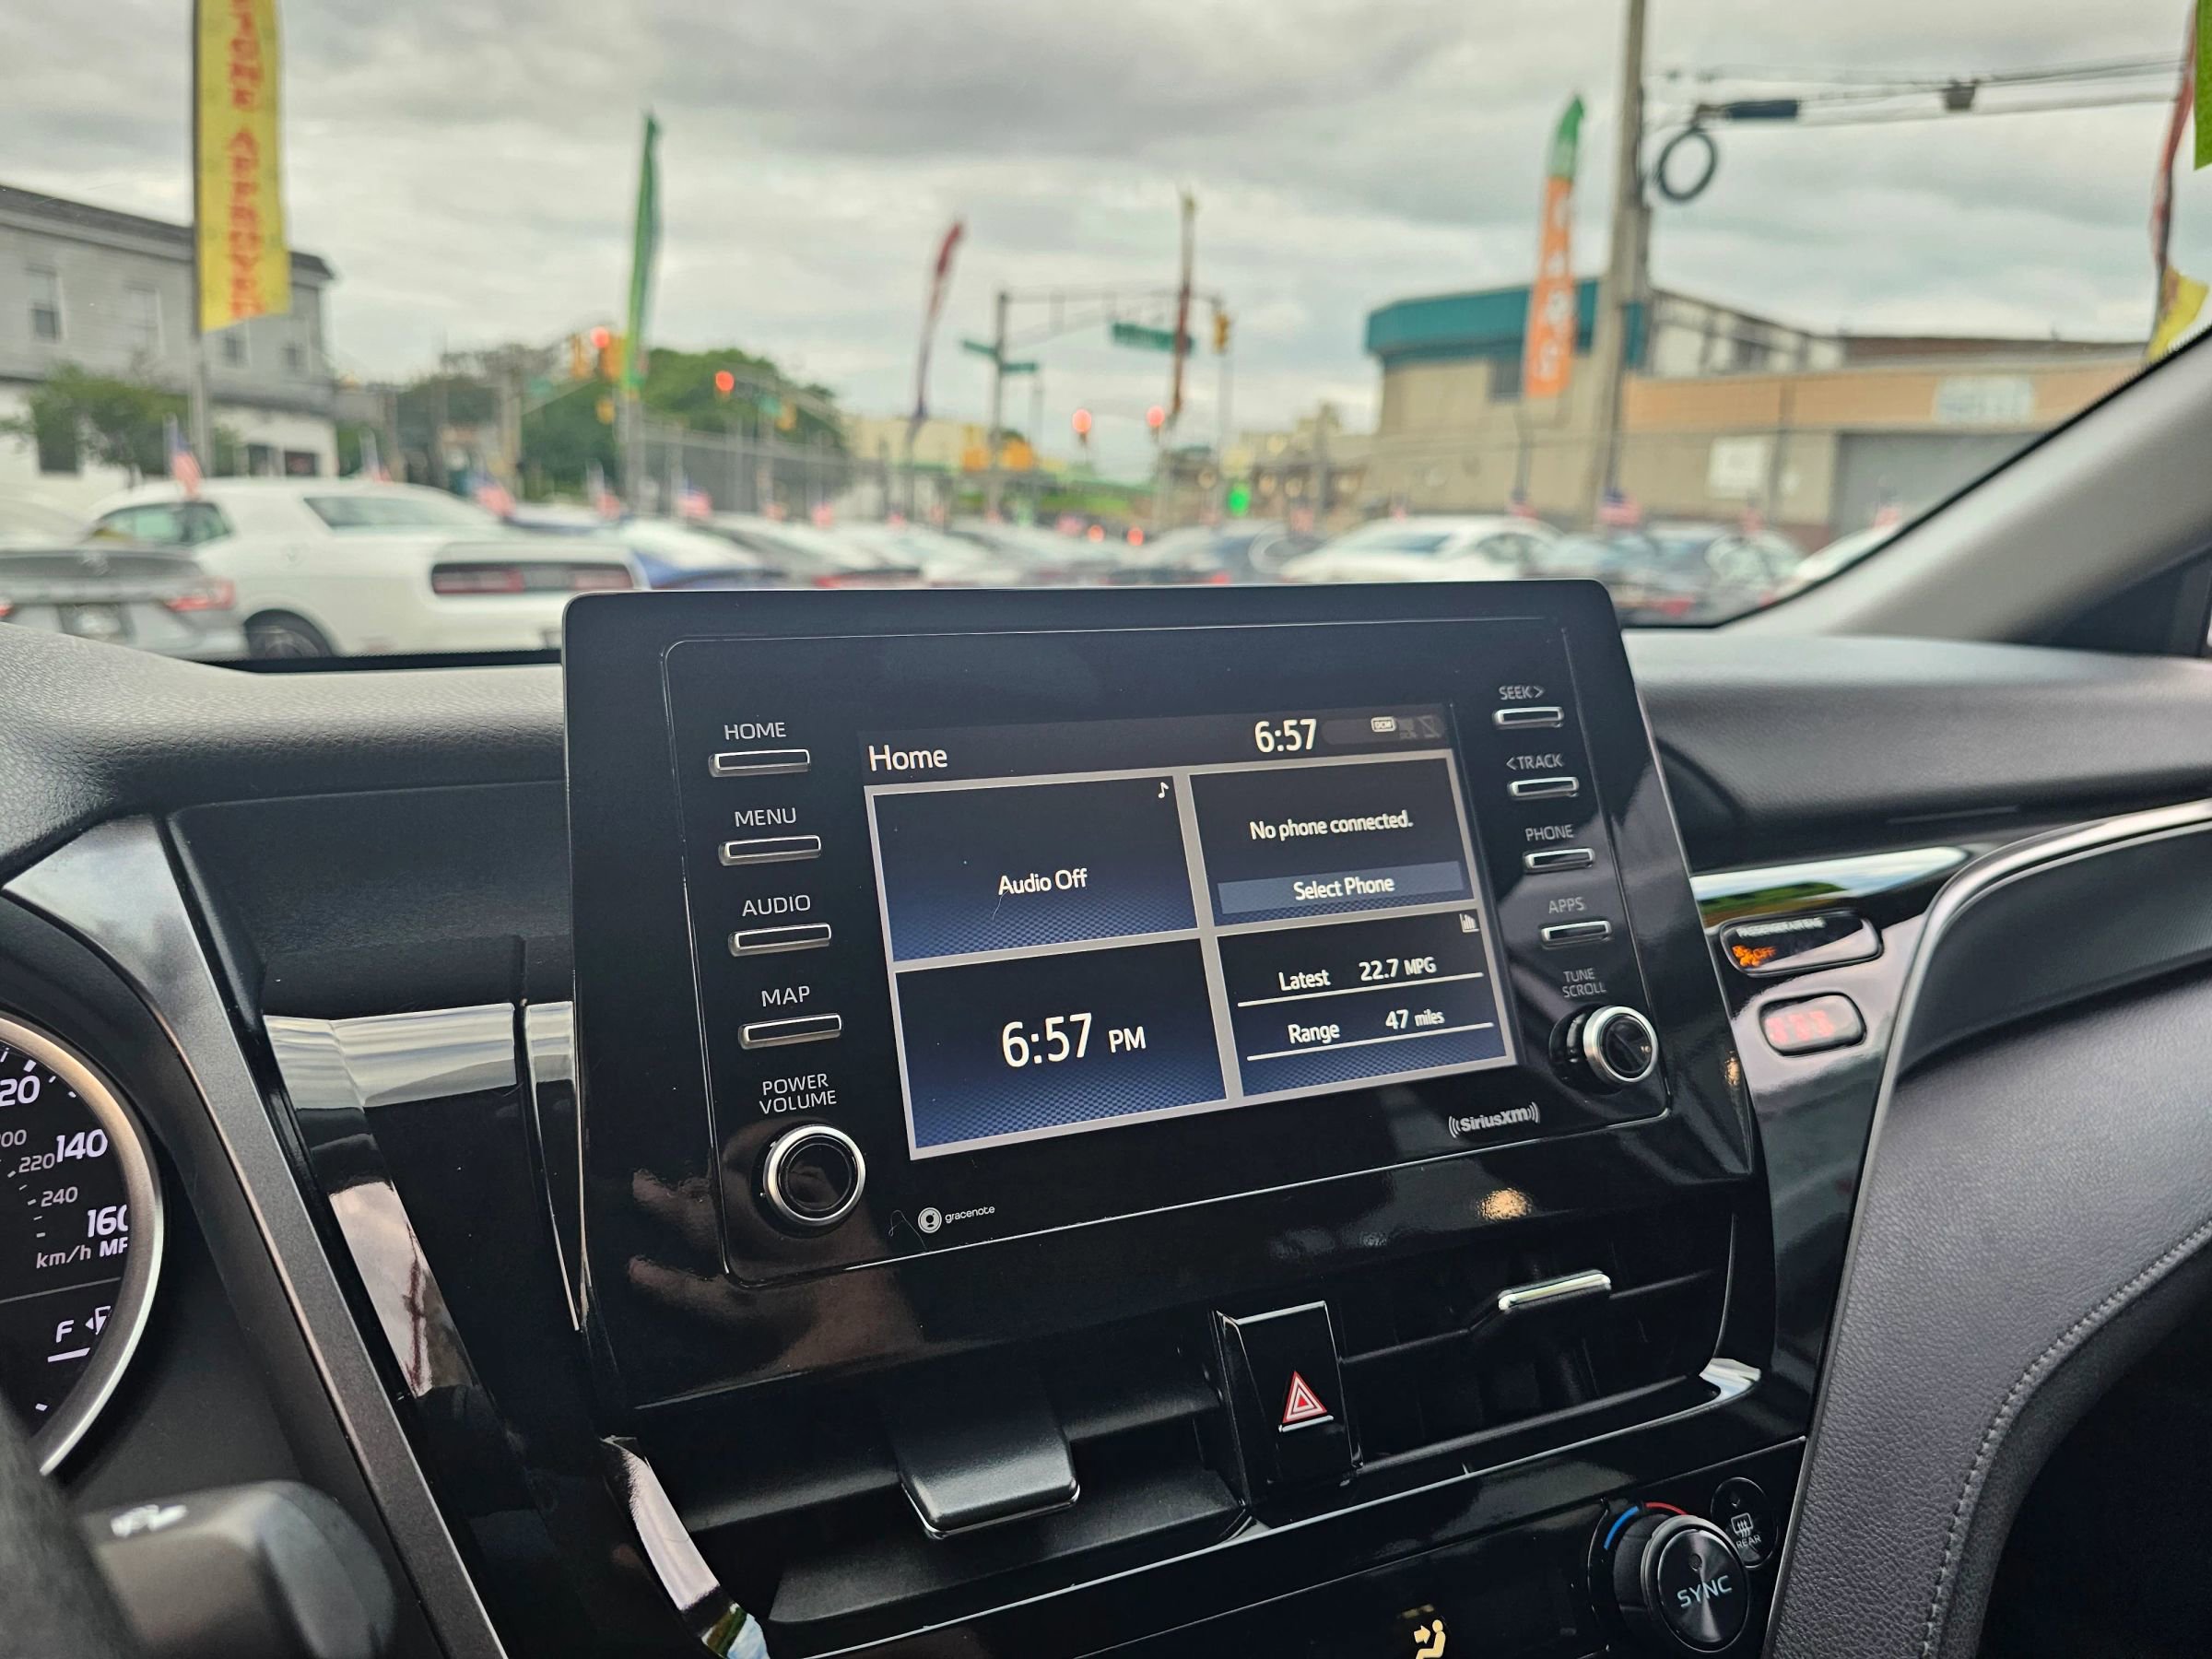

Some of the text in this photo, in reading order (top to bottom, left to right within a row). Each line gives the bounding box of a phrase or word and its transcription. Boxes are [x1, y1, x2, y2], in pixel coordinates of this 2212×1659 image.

[724, 722, 787, 740] HOME
[1254, 718, 1317, 753] 6:57
[868, 745, 948, 771] Home
[735, 807, 797, 827] MENU
[1249, 809, 1414, 841] No phone connected.
[1525, 824, 1575, 841] PHONE
[998, 868, 1088, 895] Audio Off
[1293, 877, 1395, 901] Select Phone
[742, 894, 812, 917] AUDIO
[1548, 896, 1587, 914] APPS
[1278, 956, 1438, 992] Latest 22.7 MPG
[1563, 968, 1595, 982] TUNE
[761, 985, 810, 1007] MAP
[1562, 982, 1606, 998] SCROLL
[1288, 1008, 1445, 1044] Range 47 miles
[1002, 1012, 1146, 1067] 6:57 PM
[0, 1075, 41, 1107] 20
[762, 1073, 829, 1096] POWER
[759, 1089, 837, 1114] VOLUME
[0, 1129, 27, 1147] 00
[56, 1128, 108, 1162] 140
[18, 1153, 55, 1173] 220
[41, 1186, 78, 1207] 240
[945, 1206, 995, 1224] gracenote
[36, 1245, 91, 1268] km/h
[99, 1237, 128, 1257] MP
[55, 1319, 74, 1343] F
[1735, 1534, 1761, 1549] REAR
[1677, 1575, 1732, 1608] SYNC
